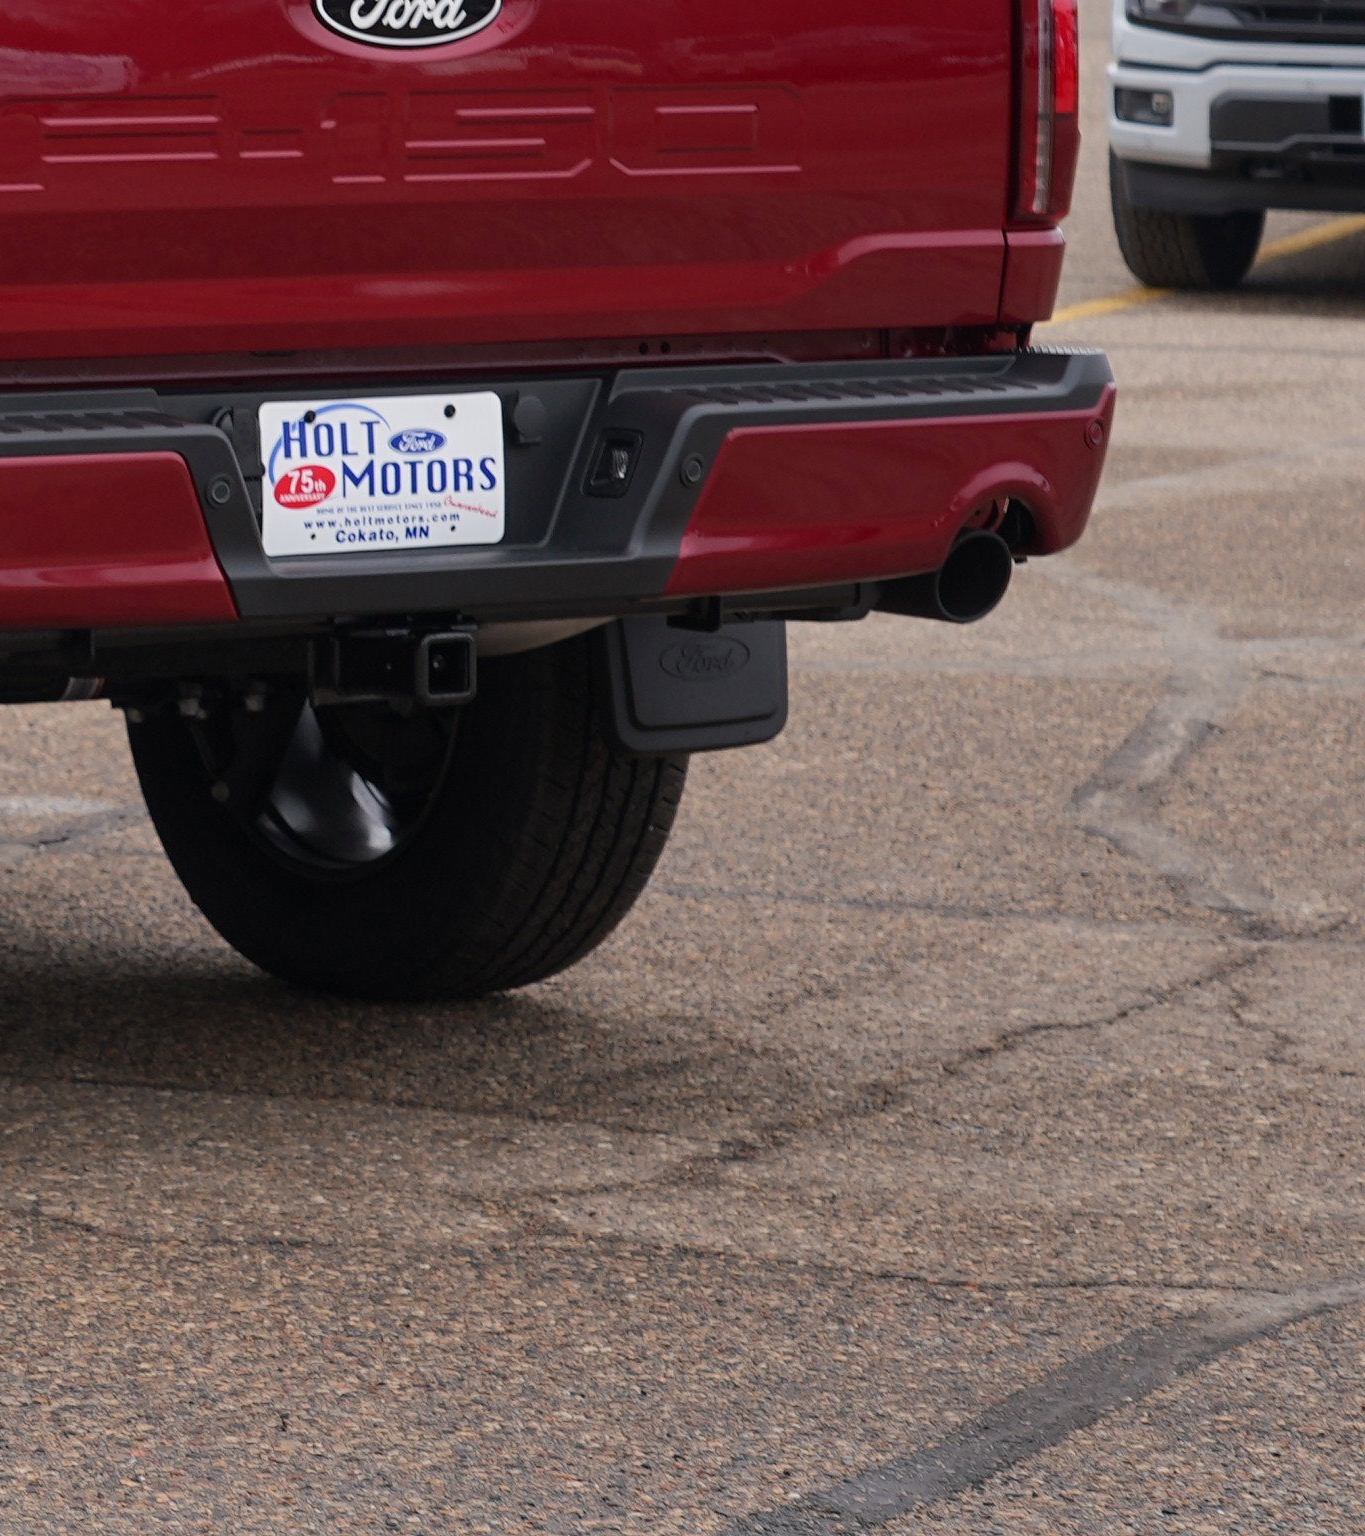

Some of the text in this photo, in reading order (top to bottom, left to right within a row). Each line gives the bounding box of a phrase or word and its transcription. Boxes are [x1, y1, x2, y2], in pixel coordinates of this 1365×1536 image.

[282, 421, 380, 459] HOLT
[398, 432, 436, 452] Ford
[287, 469, 327, 495] 75th
[342, 457, 497, 498] MOTORS
[304, 513, 460, 529] www.holtmotors.com
[336, 526, 429, 543] Cokato, MN
